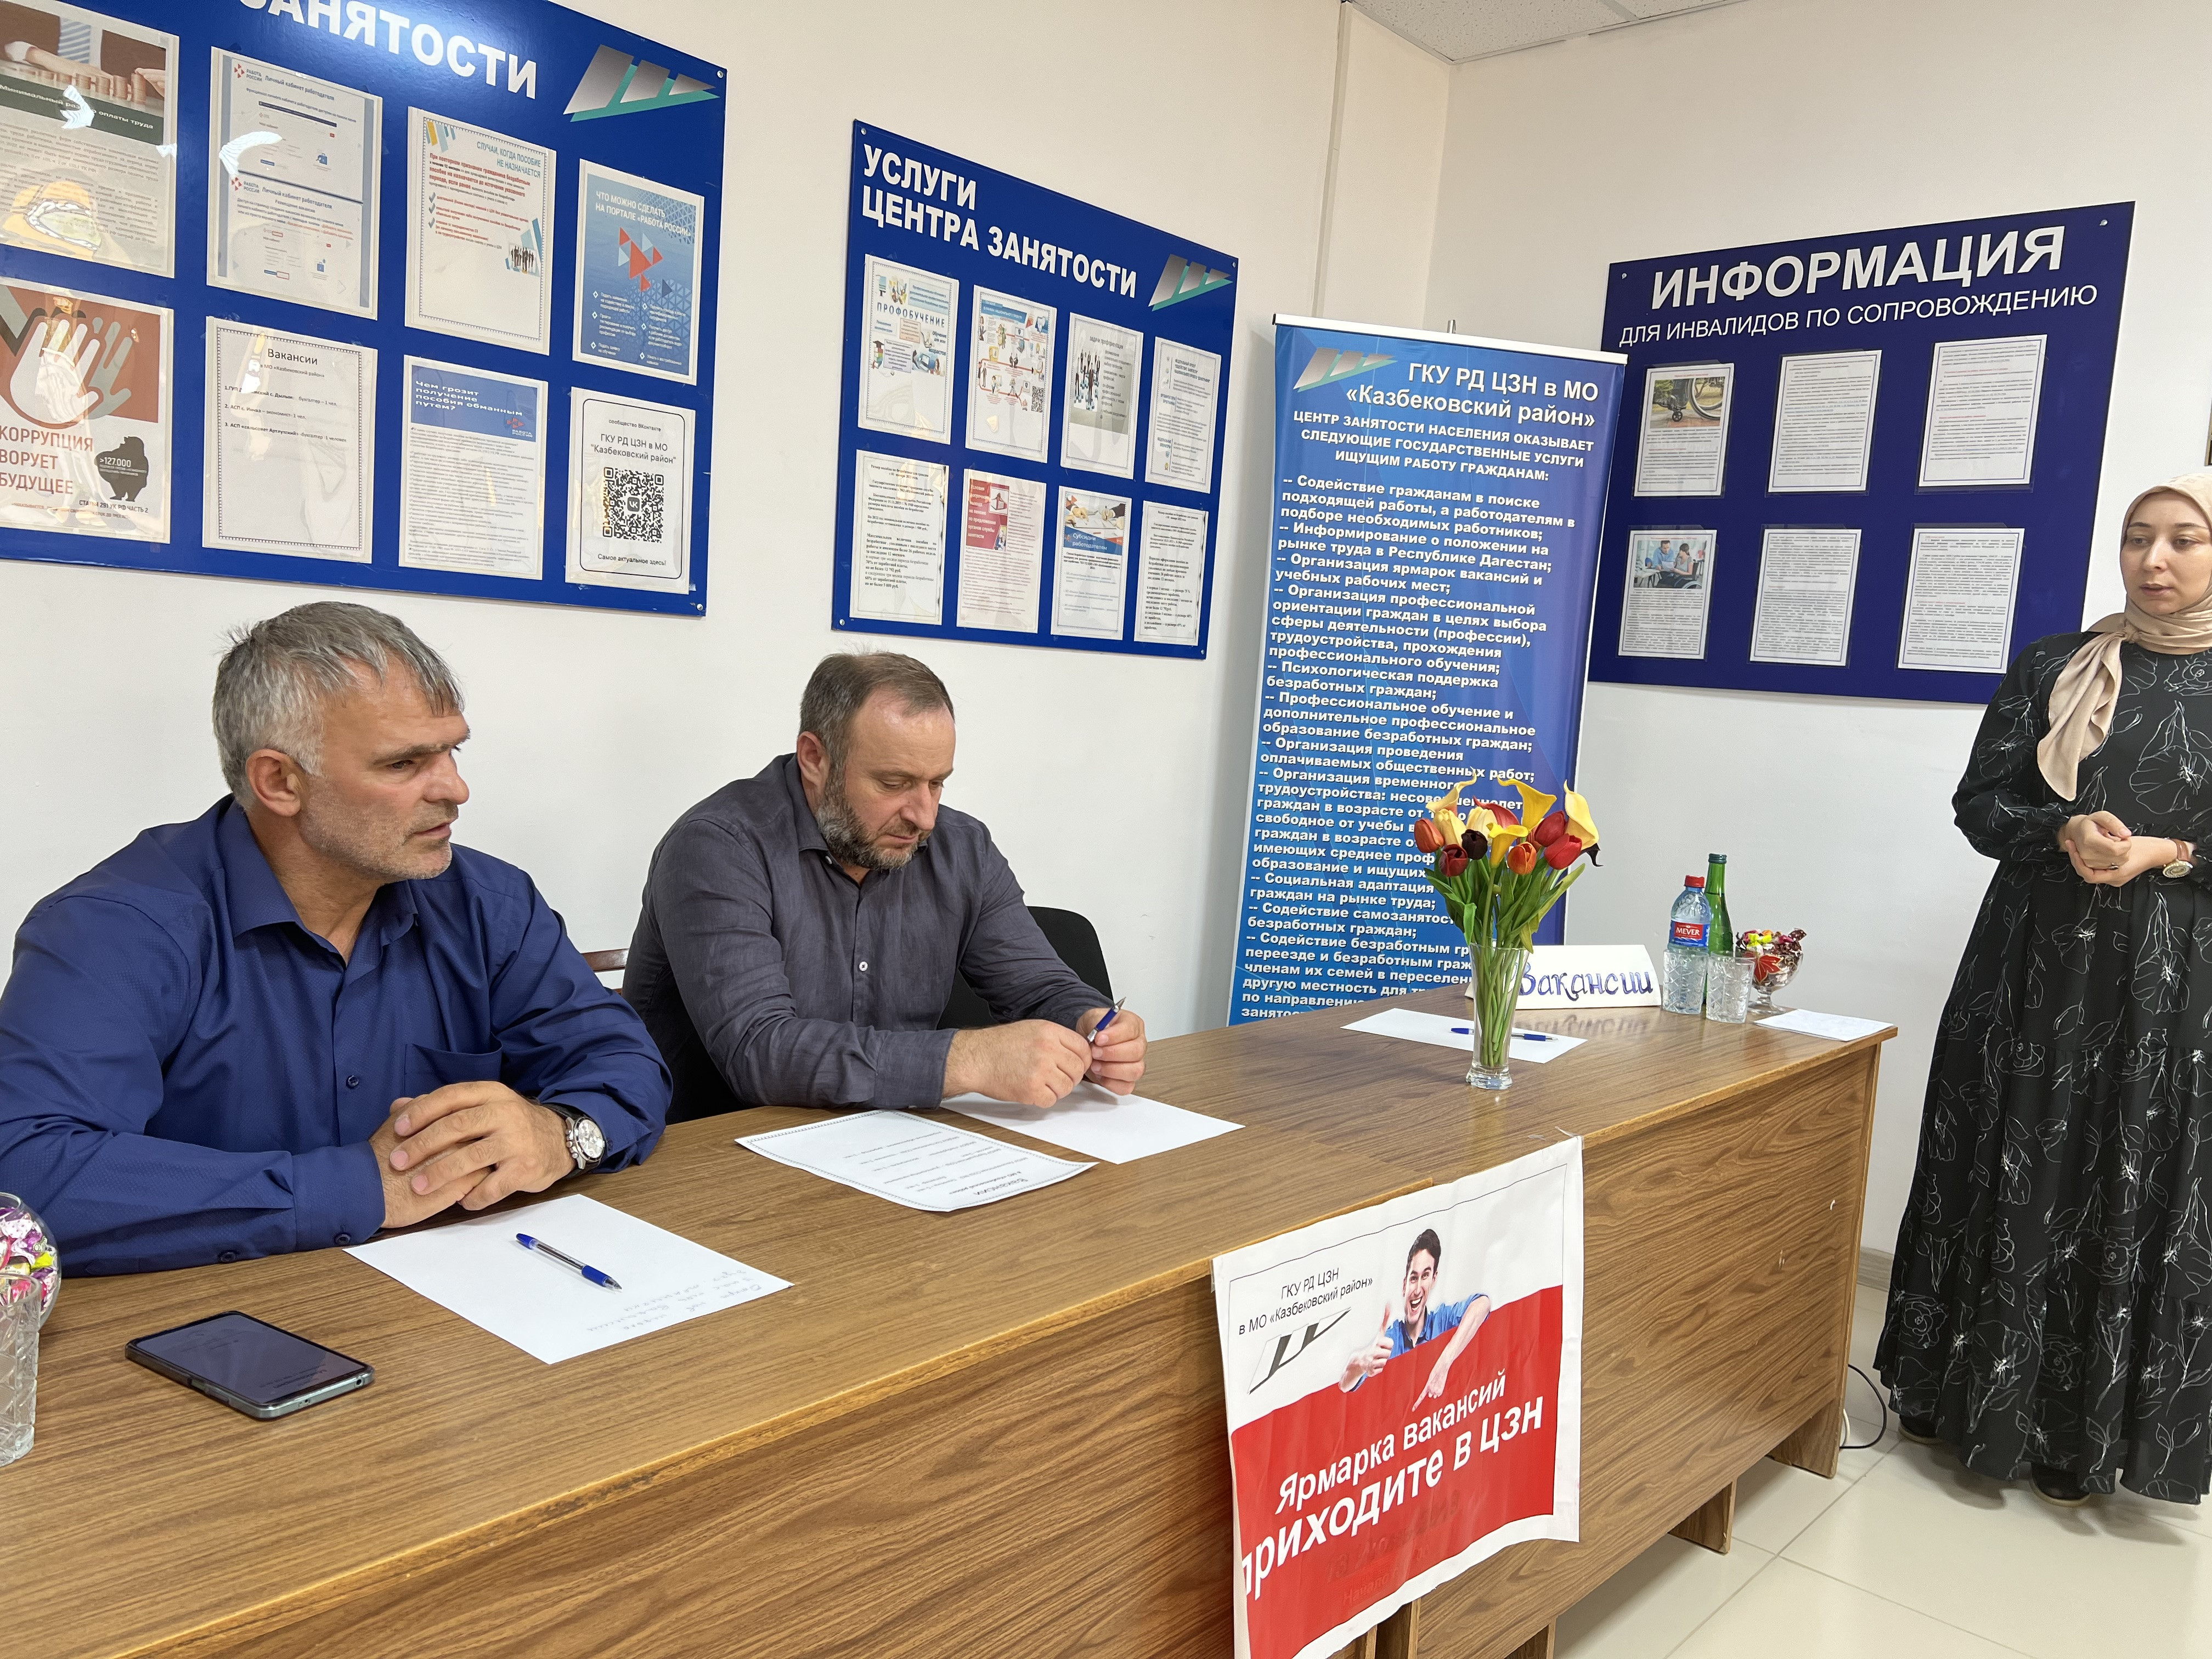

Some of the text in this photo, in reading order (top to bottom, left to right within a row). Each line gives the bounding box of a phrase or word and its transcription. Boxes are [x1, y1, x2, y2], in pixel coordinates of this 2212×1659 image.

[240, 0, 536, 99] АНЯТОСТИ
[477, 141, 541, 167] СЛУЧАИ, КОГДА ПОСОБИЕ
[497, 159, 540, 178] НЕ НАЗНАЧАЕТСЯ
[864, 144, 976, 210] УСЛУГИ
[596, 191, 665, 218] ЧТО МОЖНО СДЕЛАТЬ
[596, 202, 691, 236] НА ПОРТАЛЕ «РАБОТА РОССИИ»
[862, 185, 1136, 298] ЦЕНТРА ЗАНЯТОСТИ
[1652, 226, 2064, 309] ИНФОРМАЦИЯ
[877, 302, 945, 328] ПРОФОБУЧЕНИЕ
[1619, 285, 2097, 347] ДЛЯ ИНВАЛИДОВ ПО СОПРОВОЖДЕНИЮ
[268, 348, 317, 365] Вакансии
[416, 381, 479, 396] Чем грозит
[416, 388, 477, 402] получение
[1409, 363, 1598, 401] ГКУ РД ЦЗН в МО
[416, 394, 522, 416] пособия обманным
[416, 400, 455, 410] путем?
[1346, 385, 1595, 426] «Казбековский район»
[0, 425, 93, 452] КОРРУПЦИЯ
[608, 419, 661, 432] сообщество ВКонтакте
[1294, 411, 1594, 451] ЦЕНТР ЗАНЯТОСТИ НАСЕЛЕНИЯ ОКАЗЫВАЕТ
[591, 444, 676, 464] "Казбековский район"
[601, 433, 616, 443] ГКУ
[618, 436, 628, 447] РД
[631, 438, 646, 448] ЦЗН
[655, 442, 668, 452] МО
[1301, 429, 1583, 467] СЛЕДУЮЩИЕ ГОСУДАРСТВЕННЫЕ УСЛУГИ
[0, 449, 58, 469] ВОРУЕТ
[100, 456, 131, 467] >127.000
[1335, 450, 1549, 481] ИЩУЩИМ РАБОТУ ГРАЖДАНАМ:
[0, 472, 73, 494] БУДУЩЕЕ
[1297, 475, 1385, 494] Содействие
[1390, 487, 1471, 501] гражданам
[1488, 495, 1540, 508] поиске
[1073, 533, 1096, 541] Субсидии
[1281, 507, 1542, 541] подборе необходимых работников;
[1072, 541, 1107, 550] работодателям
[1278, 539, 1551, 573] рынке труда в Республике Дагестан;
[1291, 553, 1542, 585] Организация ярмарок вакансий и
[1282, 661, 1498, 688] Психологическая поддержка
[1261, 754, 1534, 783] оплачиваемых общественных работ;
[1265, 872, 1434, 894] Социальная адаптация
[1676, 927, 1700, 935] MEVER
[1512, 962, 1653, 1001] Вакансии
[1282, 1267, 1339, 1300] ГКУ РД ЦЗН
[1239, 1278, 1373, 1335] в МО «Казбековский район»
[1277, 1368, 1505, 1514] Ярмарка вакансий
[1453, 1431, 1471, 1471] в
[1480, 1396, 1543, 1453] ЦЗН
